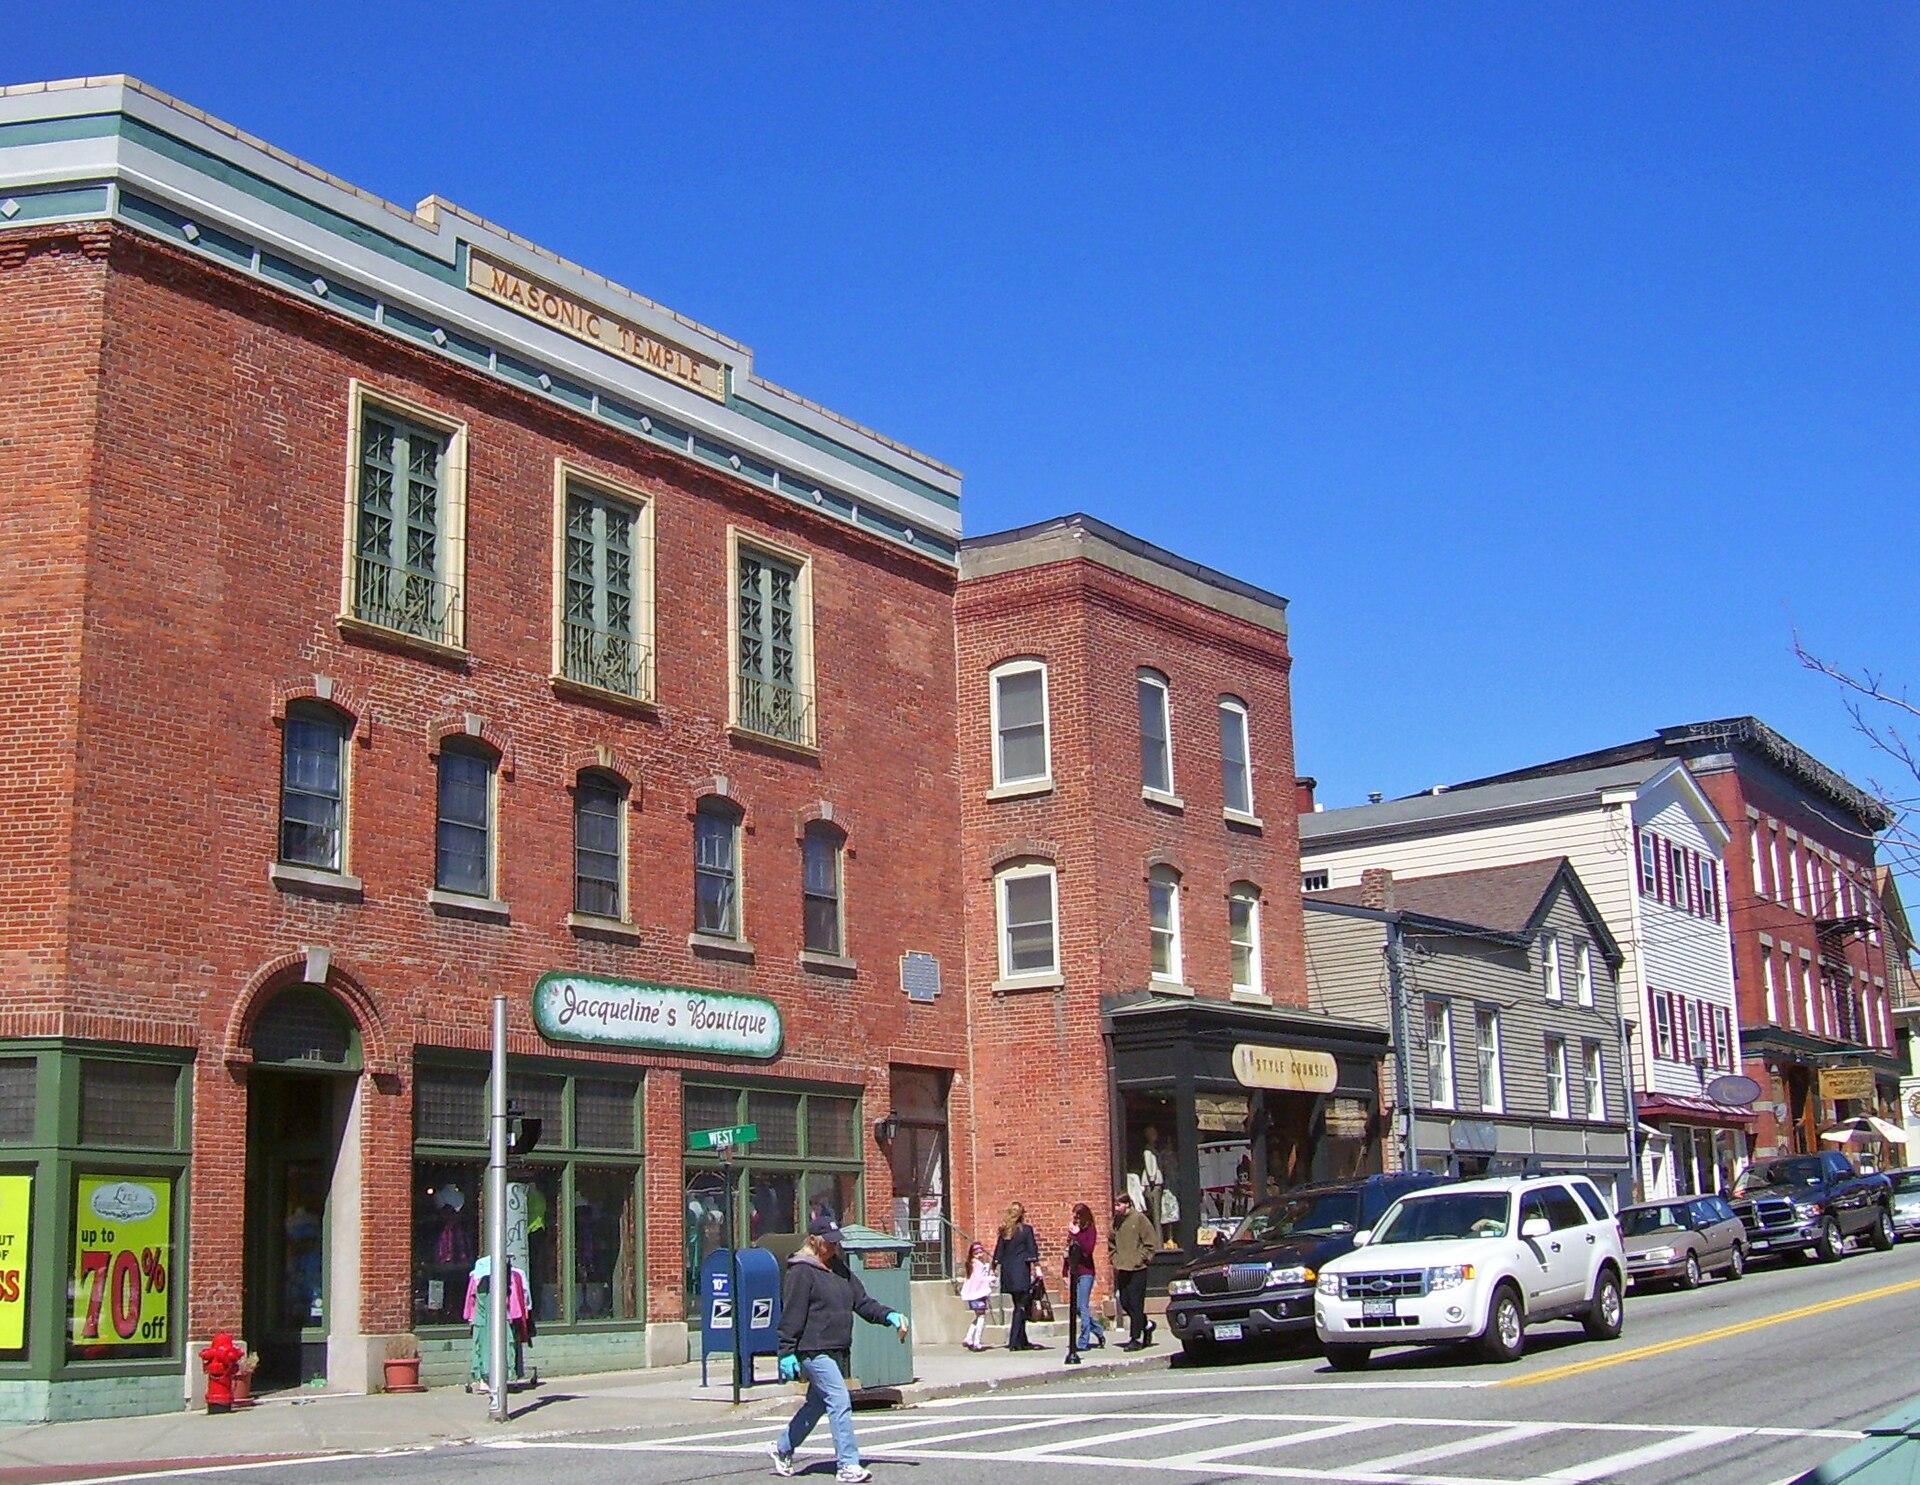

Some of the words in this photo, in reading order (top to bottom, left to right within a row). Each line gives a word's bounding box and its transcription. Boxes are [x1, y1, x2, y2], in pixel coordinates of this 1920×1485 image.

[491, 267, 600, 339] MASONIC
[618, 327, 702, 384] TEMPLE
[559, 985, 677, 1026] Jacqueline's
[687, 999, 767, 1037] Boutique
[1256, 1059, 1284, 1073] STYLE
[1292, 1062, 1328, 1078] COUNSEL
[708, 1129, 733, 1146] WEST
[81, 1229, 97, 1247] up
[101, 1227, 115, 1243] to
[81, 1247, 166, 1339] 70%
[142, 1316, 165, 1339] off
